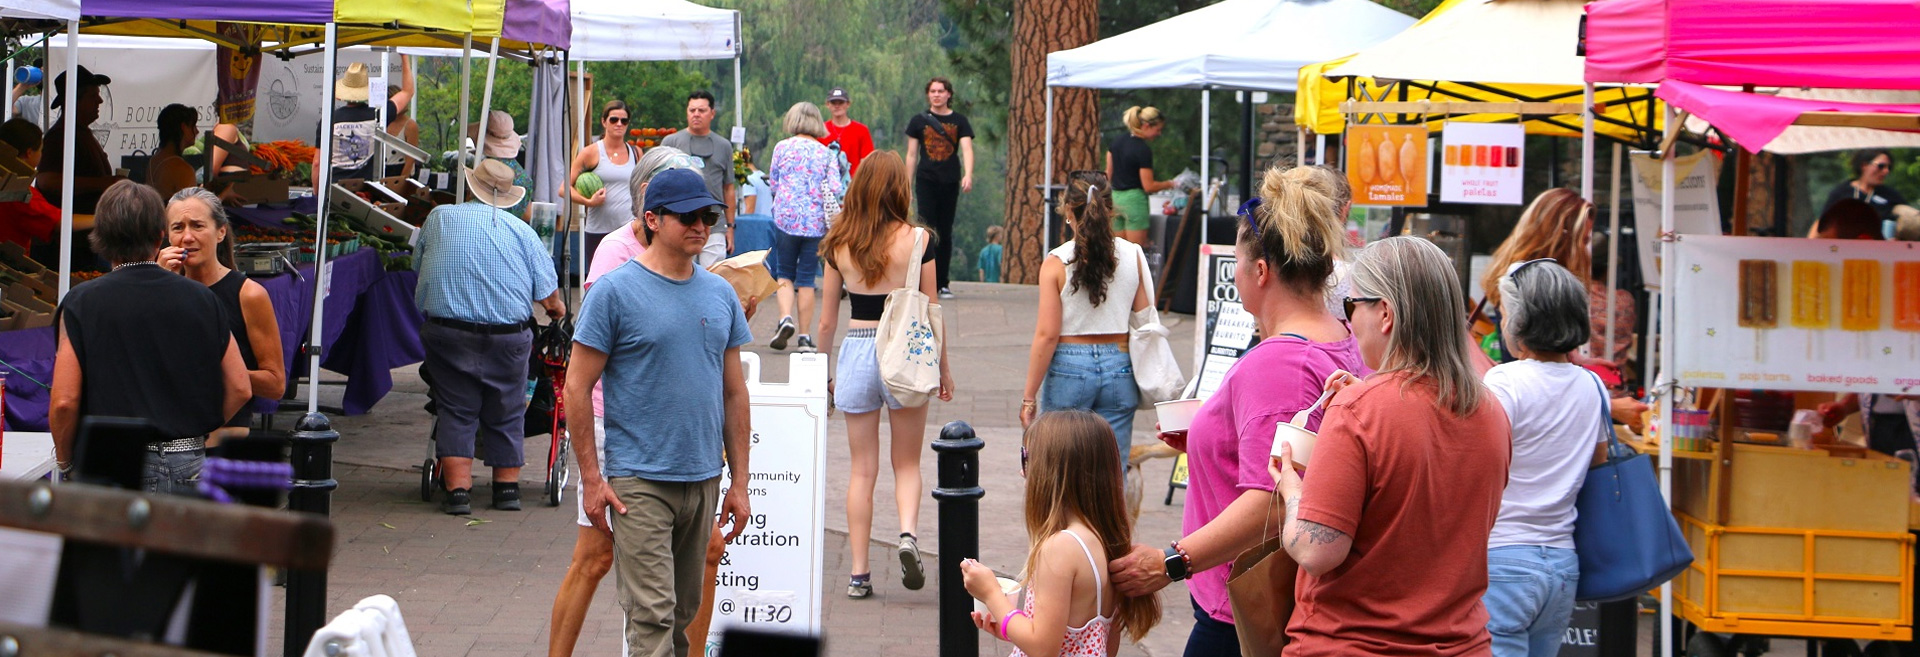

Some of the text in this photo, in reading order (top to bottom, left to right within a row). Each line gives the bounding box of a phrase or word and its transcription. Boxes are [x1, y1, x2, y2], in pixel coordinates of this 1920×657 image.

[1368, 191, 1405, 201] tamales
[1463, 188, 1497, 198] paletas
[1807, 374, 1842, 383] baked
[1845, 376, 1878, 386] goods
[720, 551, 731, 566] &
[719, 598, 735, 615] @
[744, 605, 792, 623] 11:30
